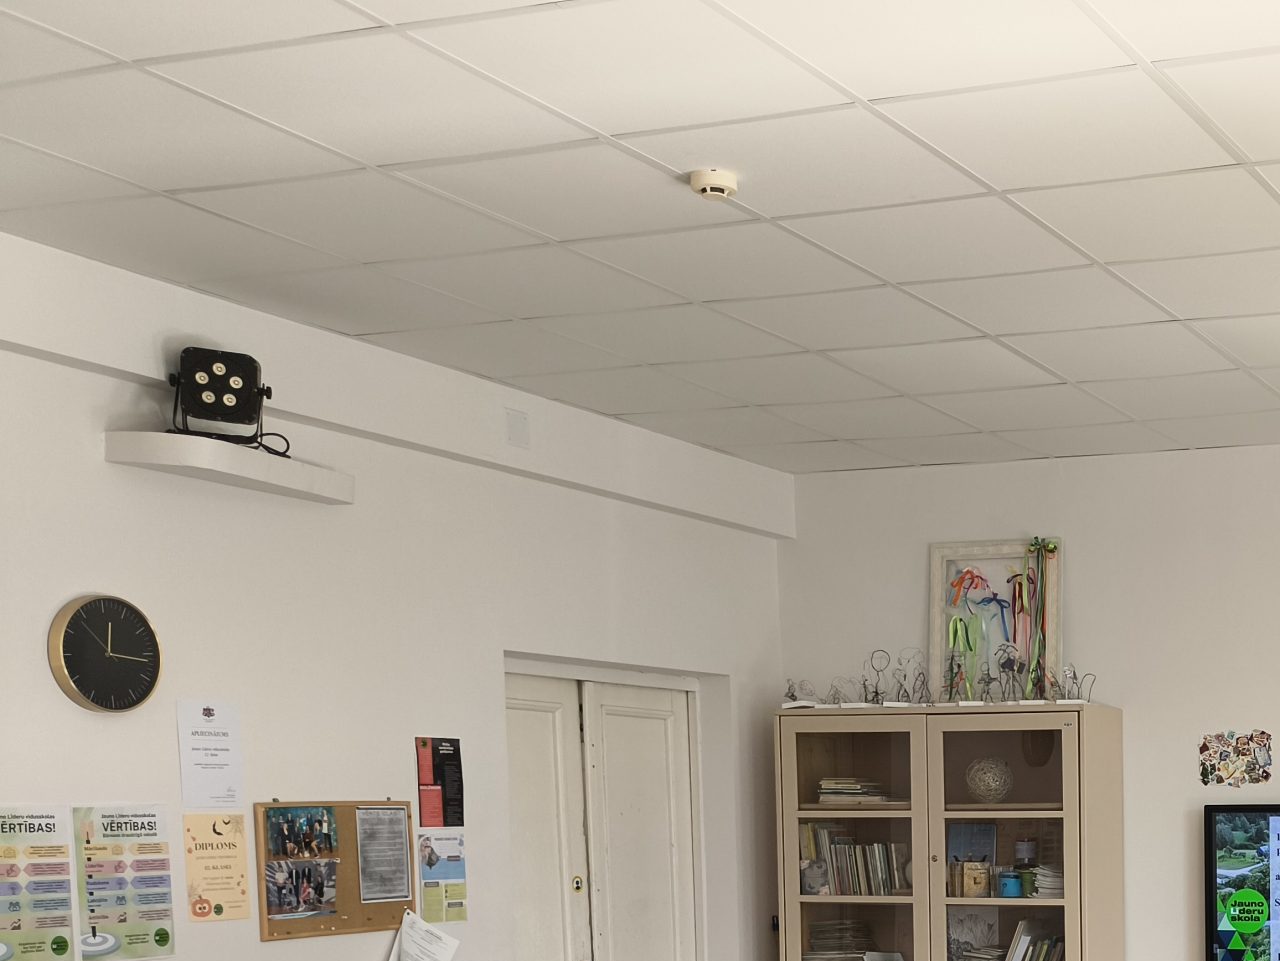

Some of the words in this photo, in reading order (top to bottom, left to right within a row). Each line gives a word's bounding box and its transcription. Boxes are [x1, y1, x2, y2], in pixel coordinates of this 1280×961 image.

[0, 820, 56, 833] ĒRTĪBAS!
[102, 820, 157, 832] VĒRTĪBAS!
[195, 841, 237, 851] DIPLOMS
